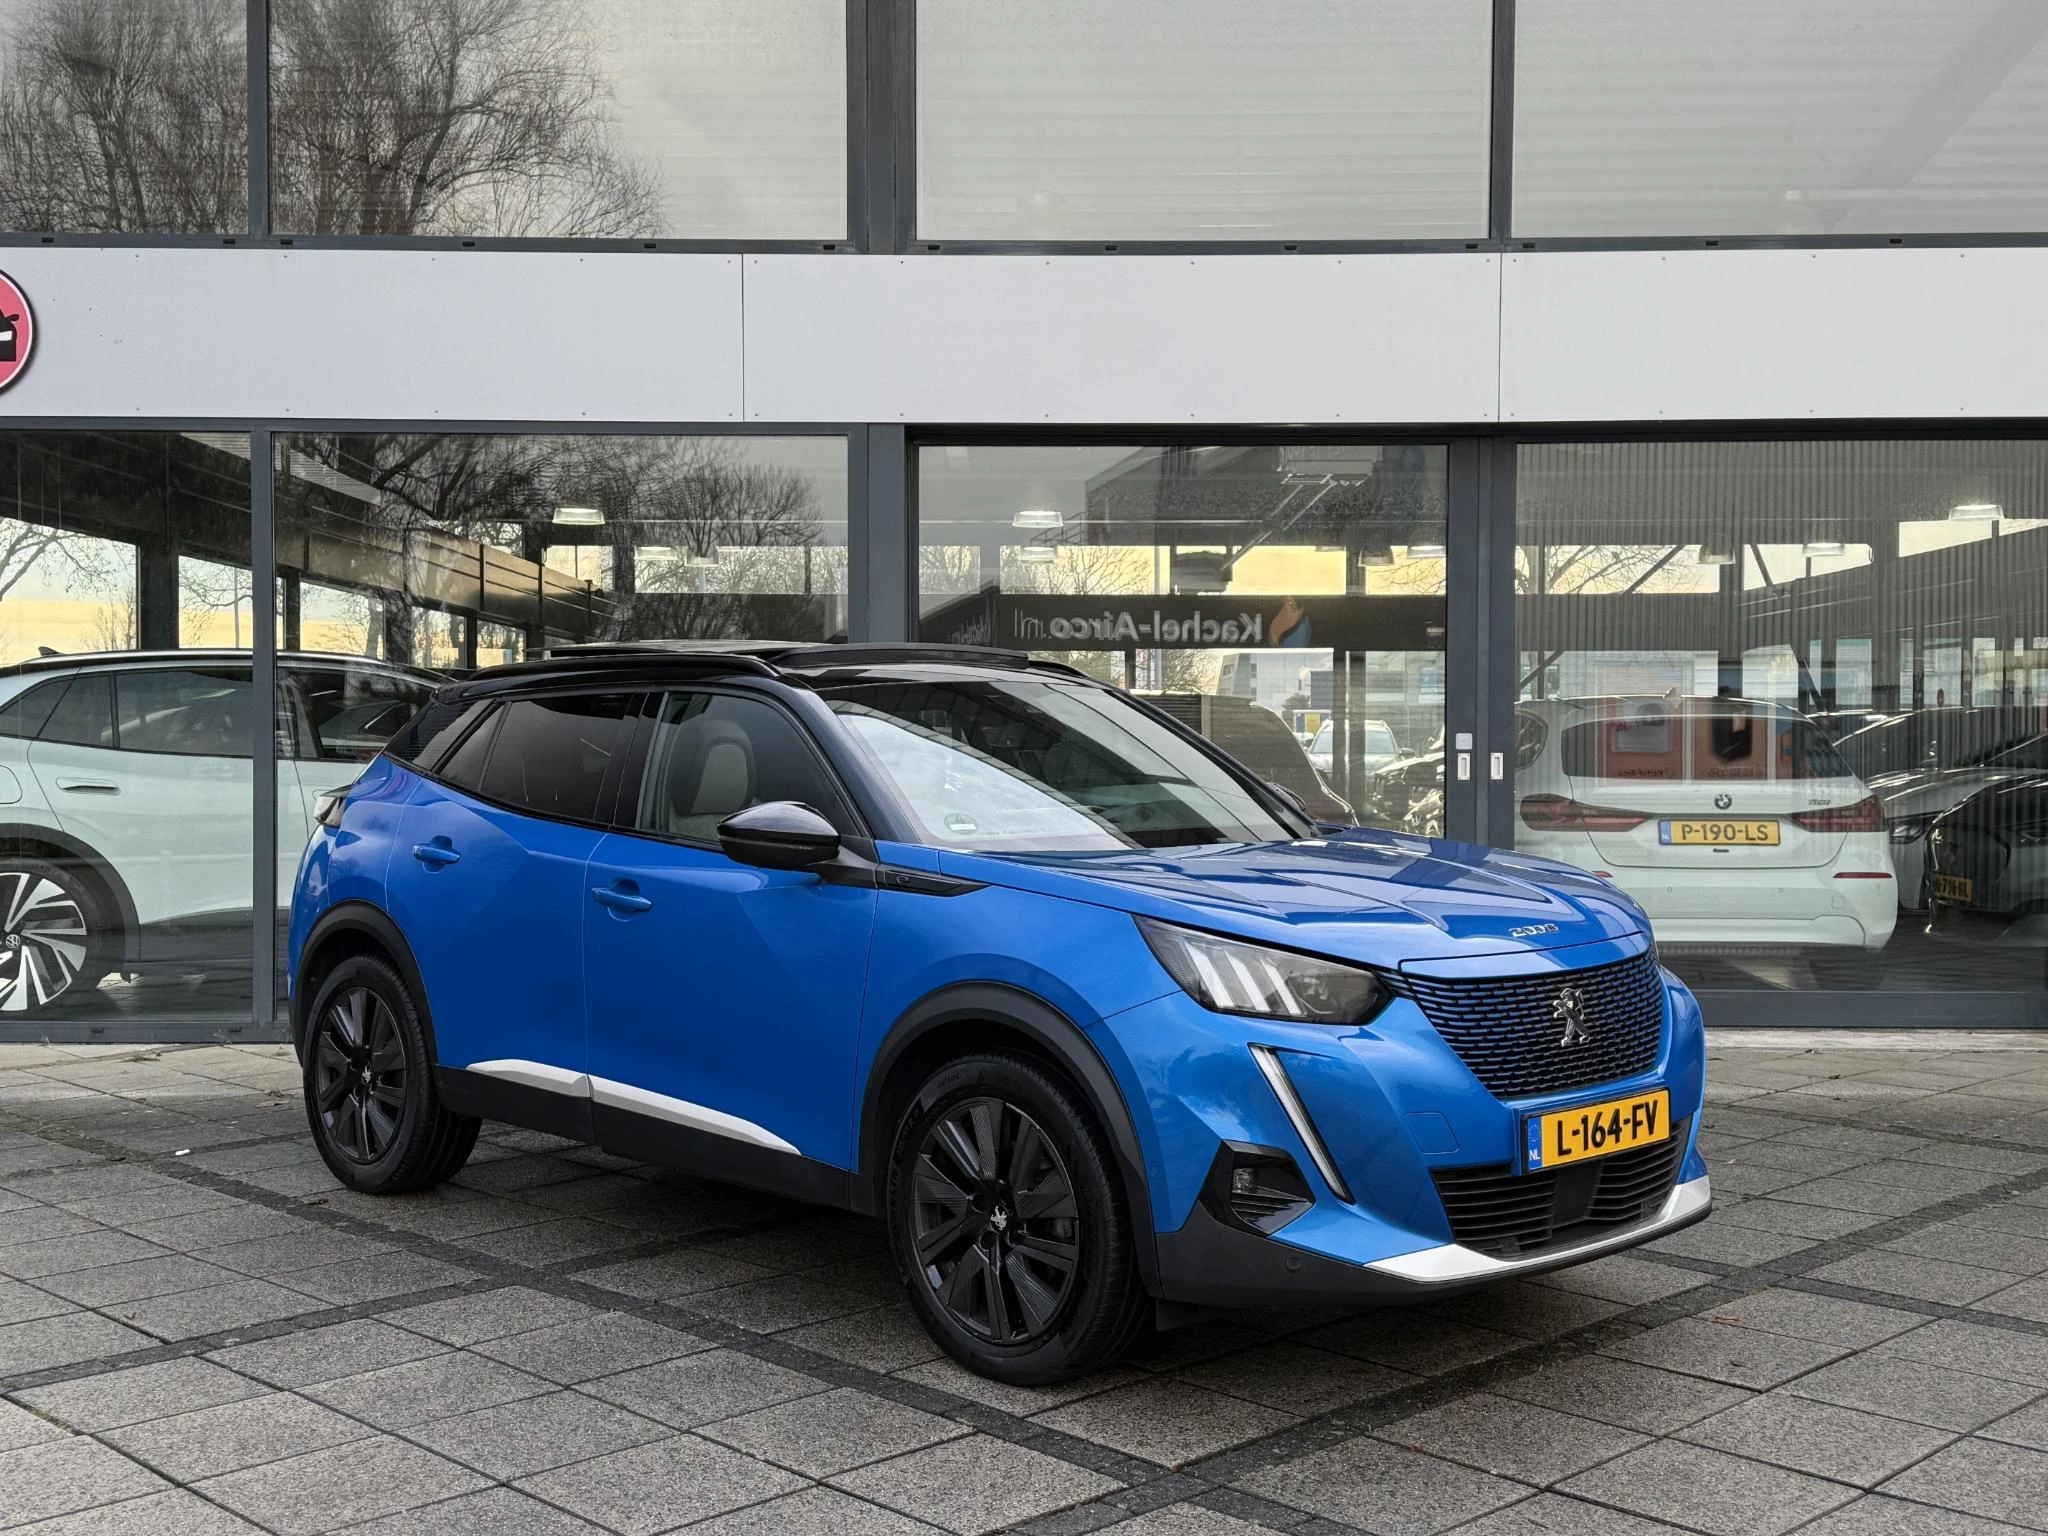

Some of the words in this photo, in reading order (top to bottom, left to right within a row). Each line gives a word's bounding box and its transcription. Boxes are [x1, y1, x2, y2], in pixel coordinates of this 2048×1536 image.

[1681, 824, 1769, 841] P-190-LS
[1509, 923, 1559, 938] 2008
[1528, 1148, 1541, 1162] NL
[1557, 1099, 1658, 1157] L-164-FV
